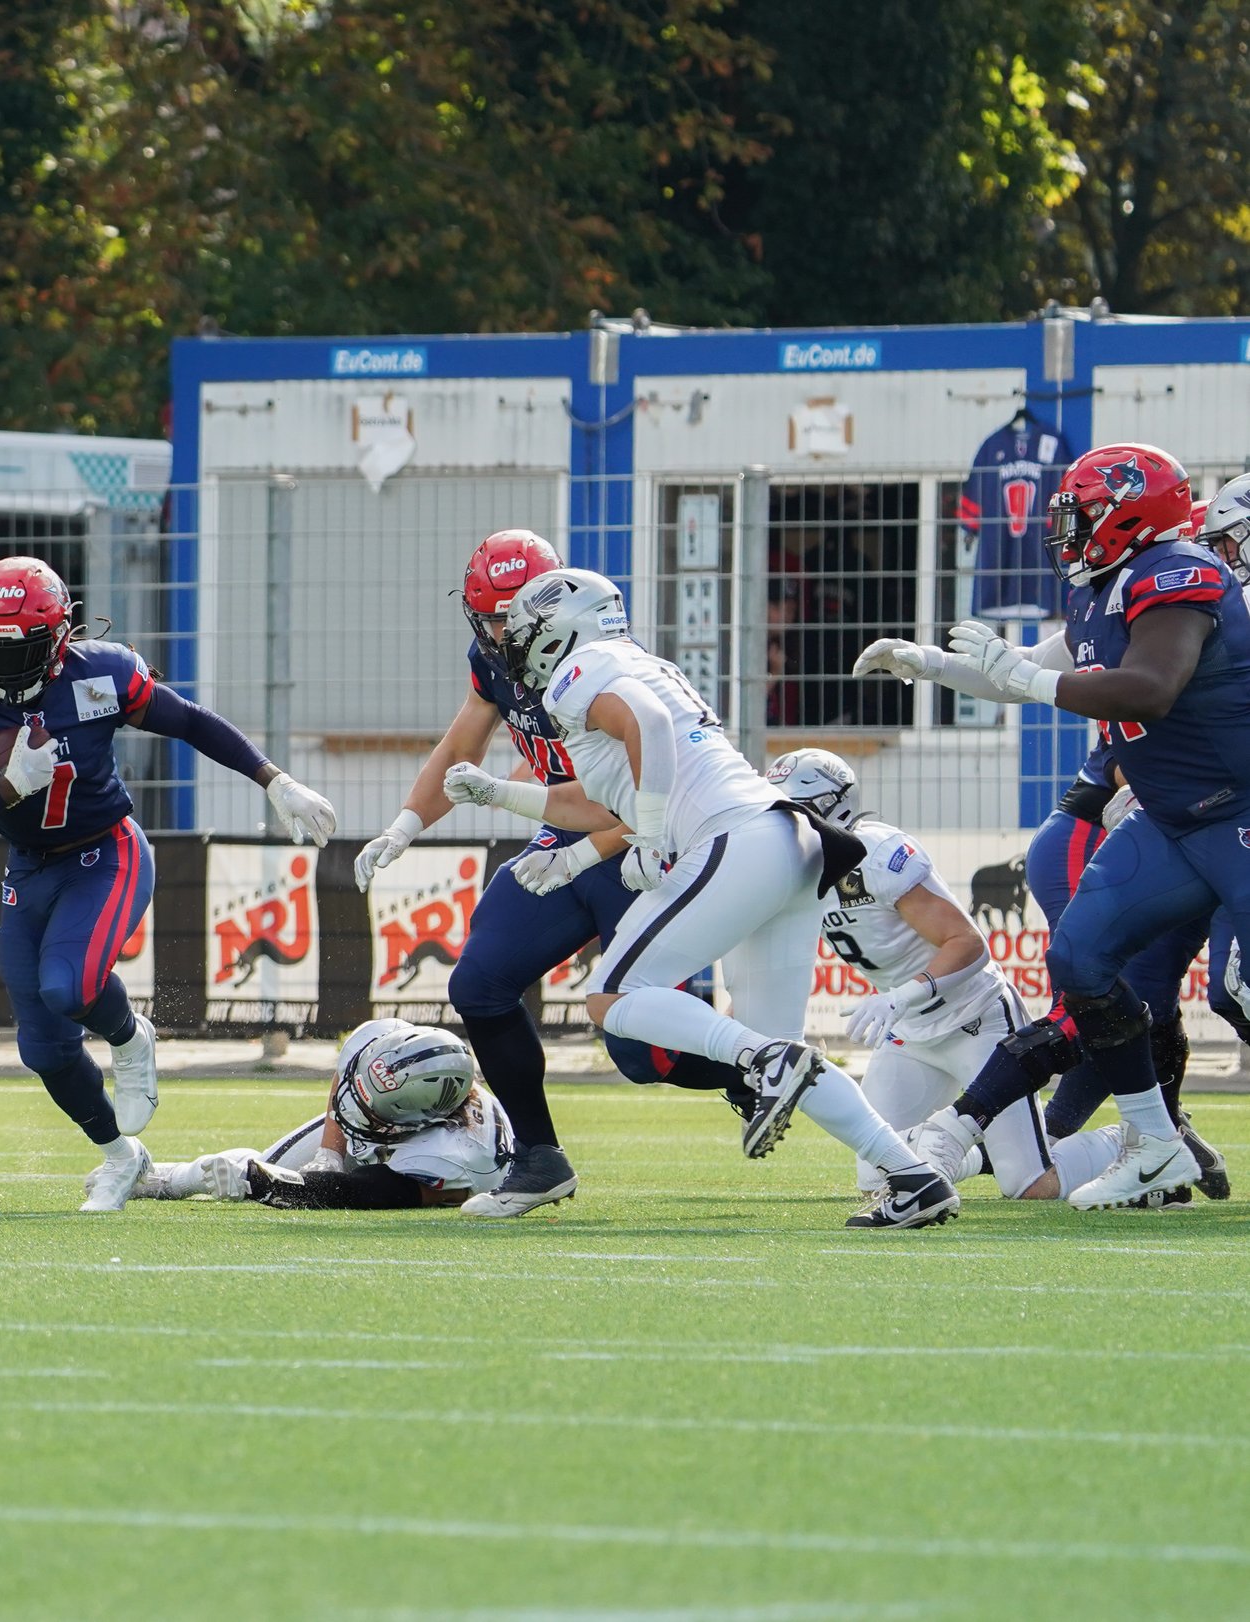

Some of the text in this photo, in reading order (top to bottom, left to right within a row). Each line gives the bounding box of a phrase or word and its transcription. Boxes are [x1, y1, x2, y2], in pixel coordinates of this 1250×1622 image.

[336, 350, 423, 373] EuCont.de
[784, 343, 876, 368] EuCont.de
[490, 557, 526, 577] Chio
[80, 705, 119, 719] 28 BLACK
[850, 896, 874, 907] BLACK
